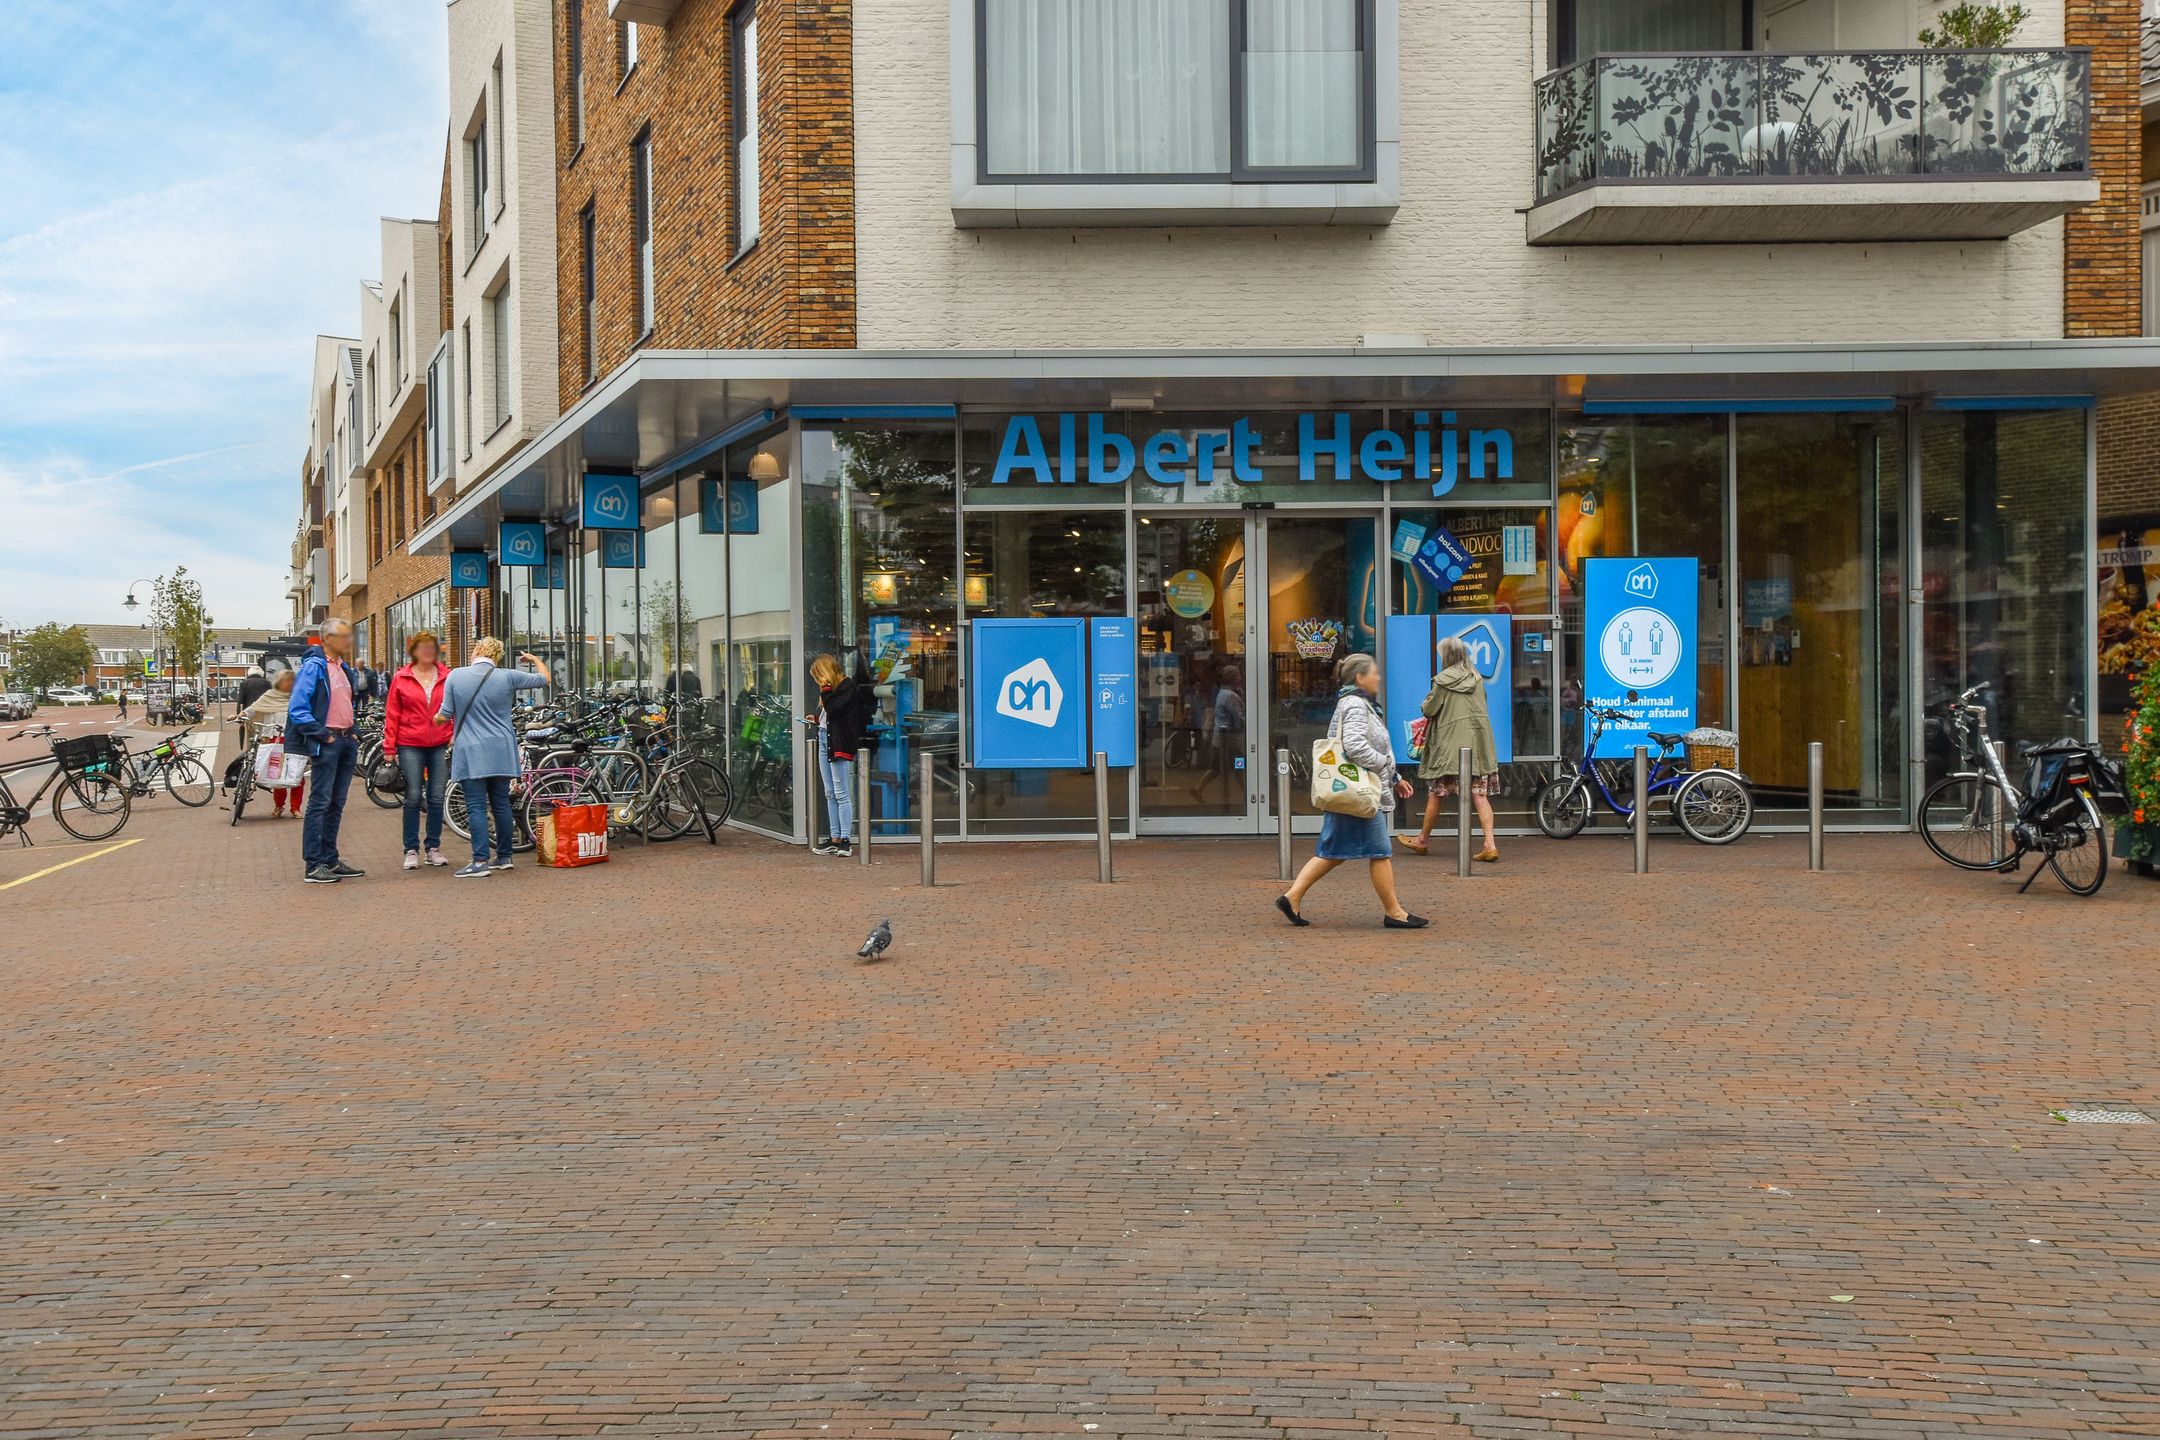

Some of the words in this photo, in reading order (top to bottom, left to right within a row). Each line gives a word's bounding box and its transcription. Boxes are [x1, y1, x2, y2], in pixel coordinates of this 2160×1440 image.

[991, 413, 1262, 483] Albert
[1300, 412, 1513, 497] Heijn
[1437, 534, 1463, 562] bol.com
[1460, 535, 1503, 554] NDVOO
[2101, 550, 2152, 564] TROMP
[1592, 696, 1620, 706] Houd
[1648, 707, 1689, 718] afstand
[1615, 719, 1651, 730] elkaar.
